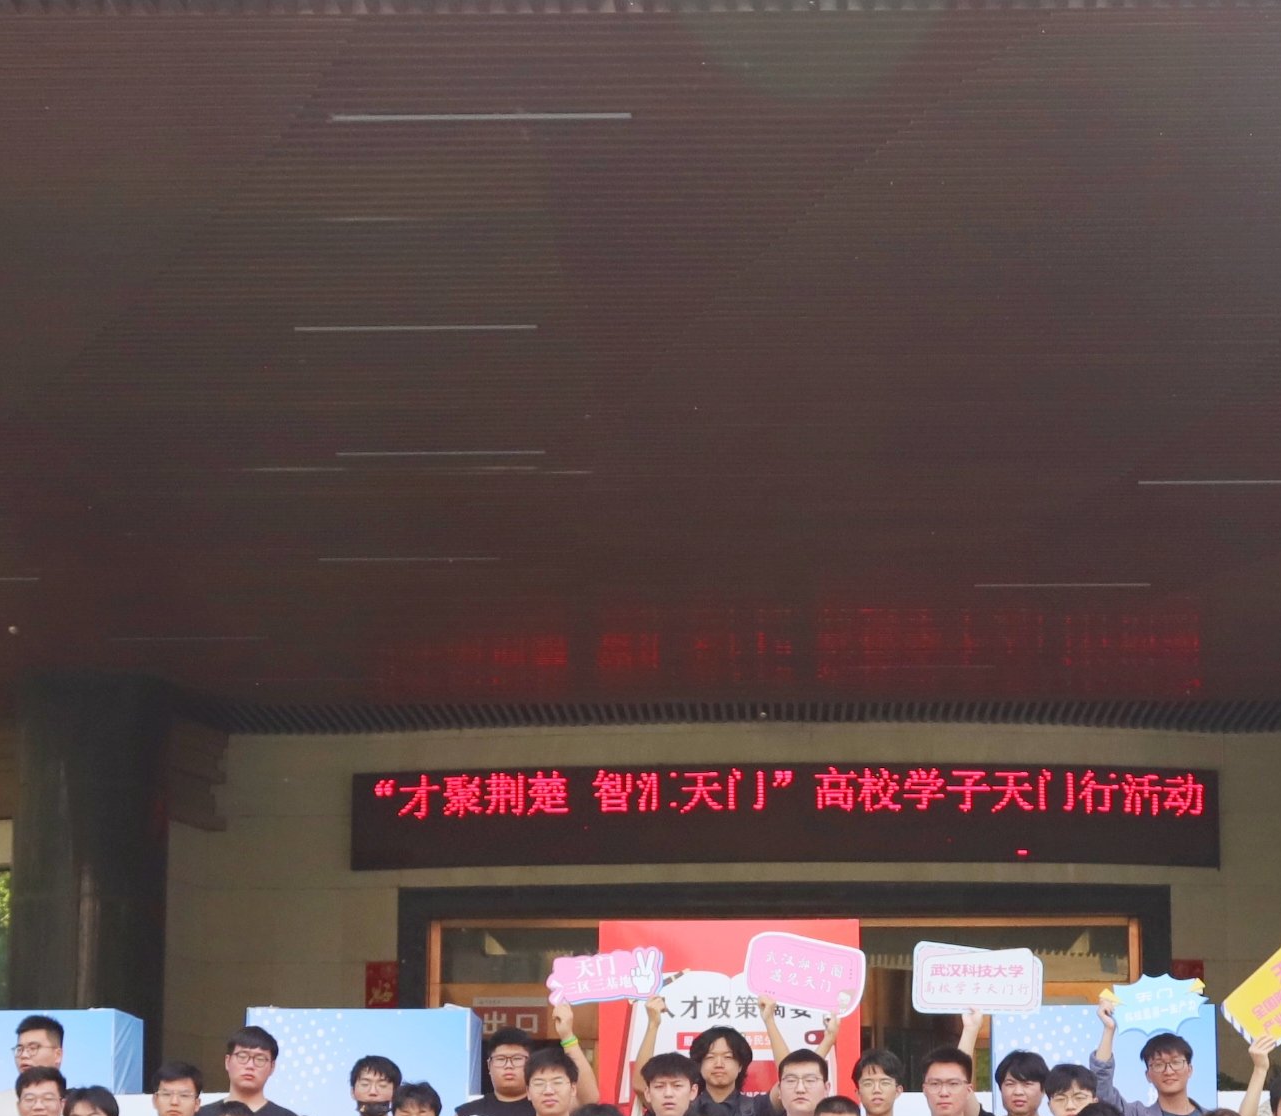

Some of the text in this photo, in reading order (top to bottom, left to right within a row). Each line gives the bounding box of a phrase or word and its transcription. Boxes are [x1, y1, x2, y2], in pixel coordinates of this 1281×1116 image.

[815, 766, 1204, 816] 高校学子天门行活动
[575, 955, 616, 978] 天门
[930, 963, 1024, 978] 武汉科技大学
[770, 968, 832, 993] 遇见天门
[924, 980, 1030, 995] 高校学子天门行
[483, 1010, 539, 1034] 出口
